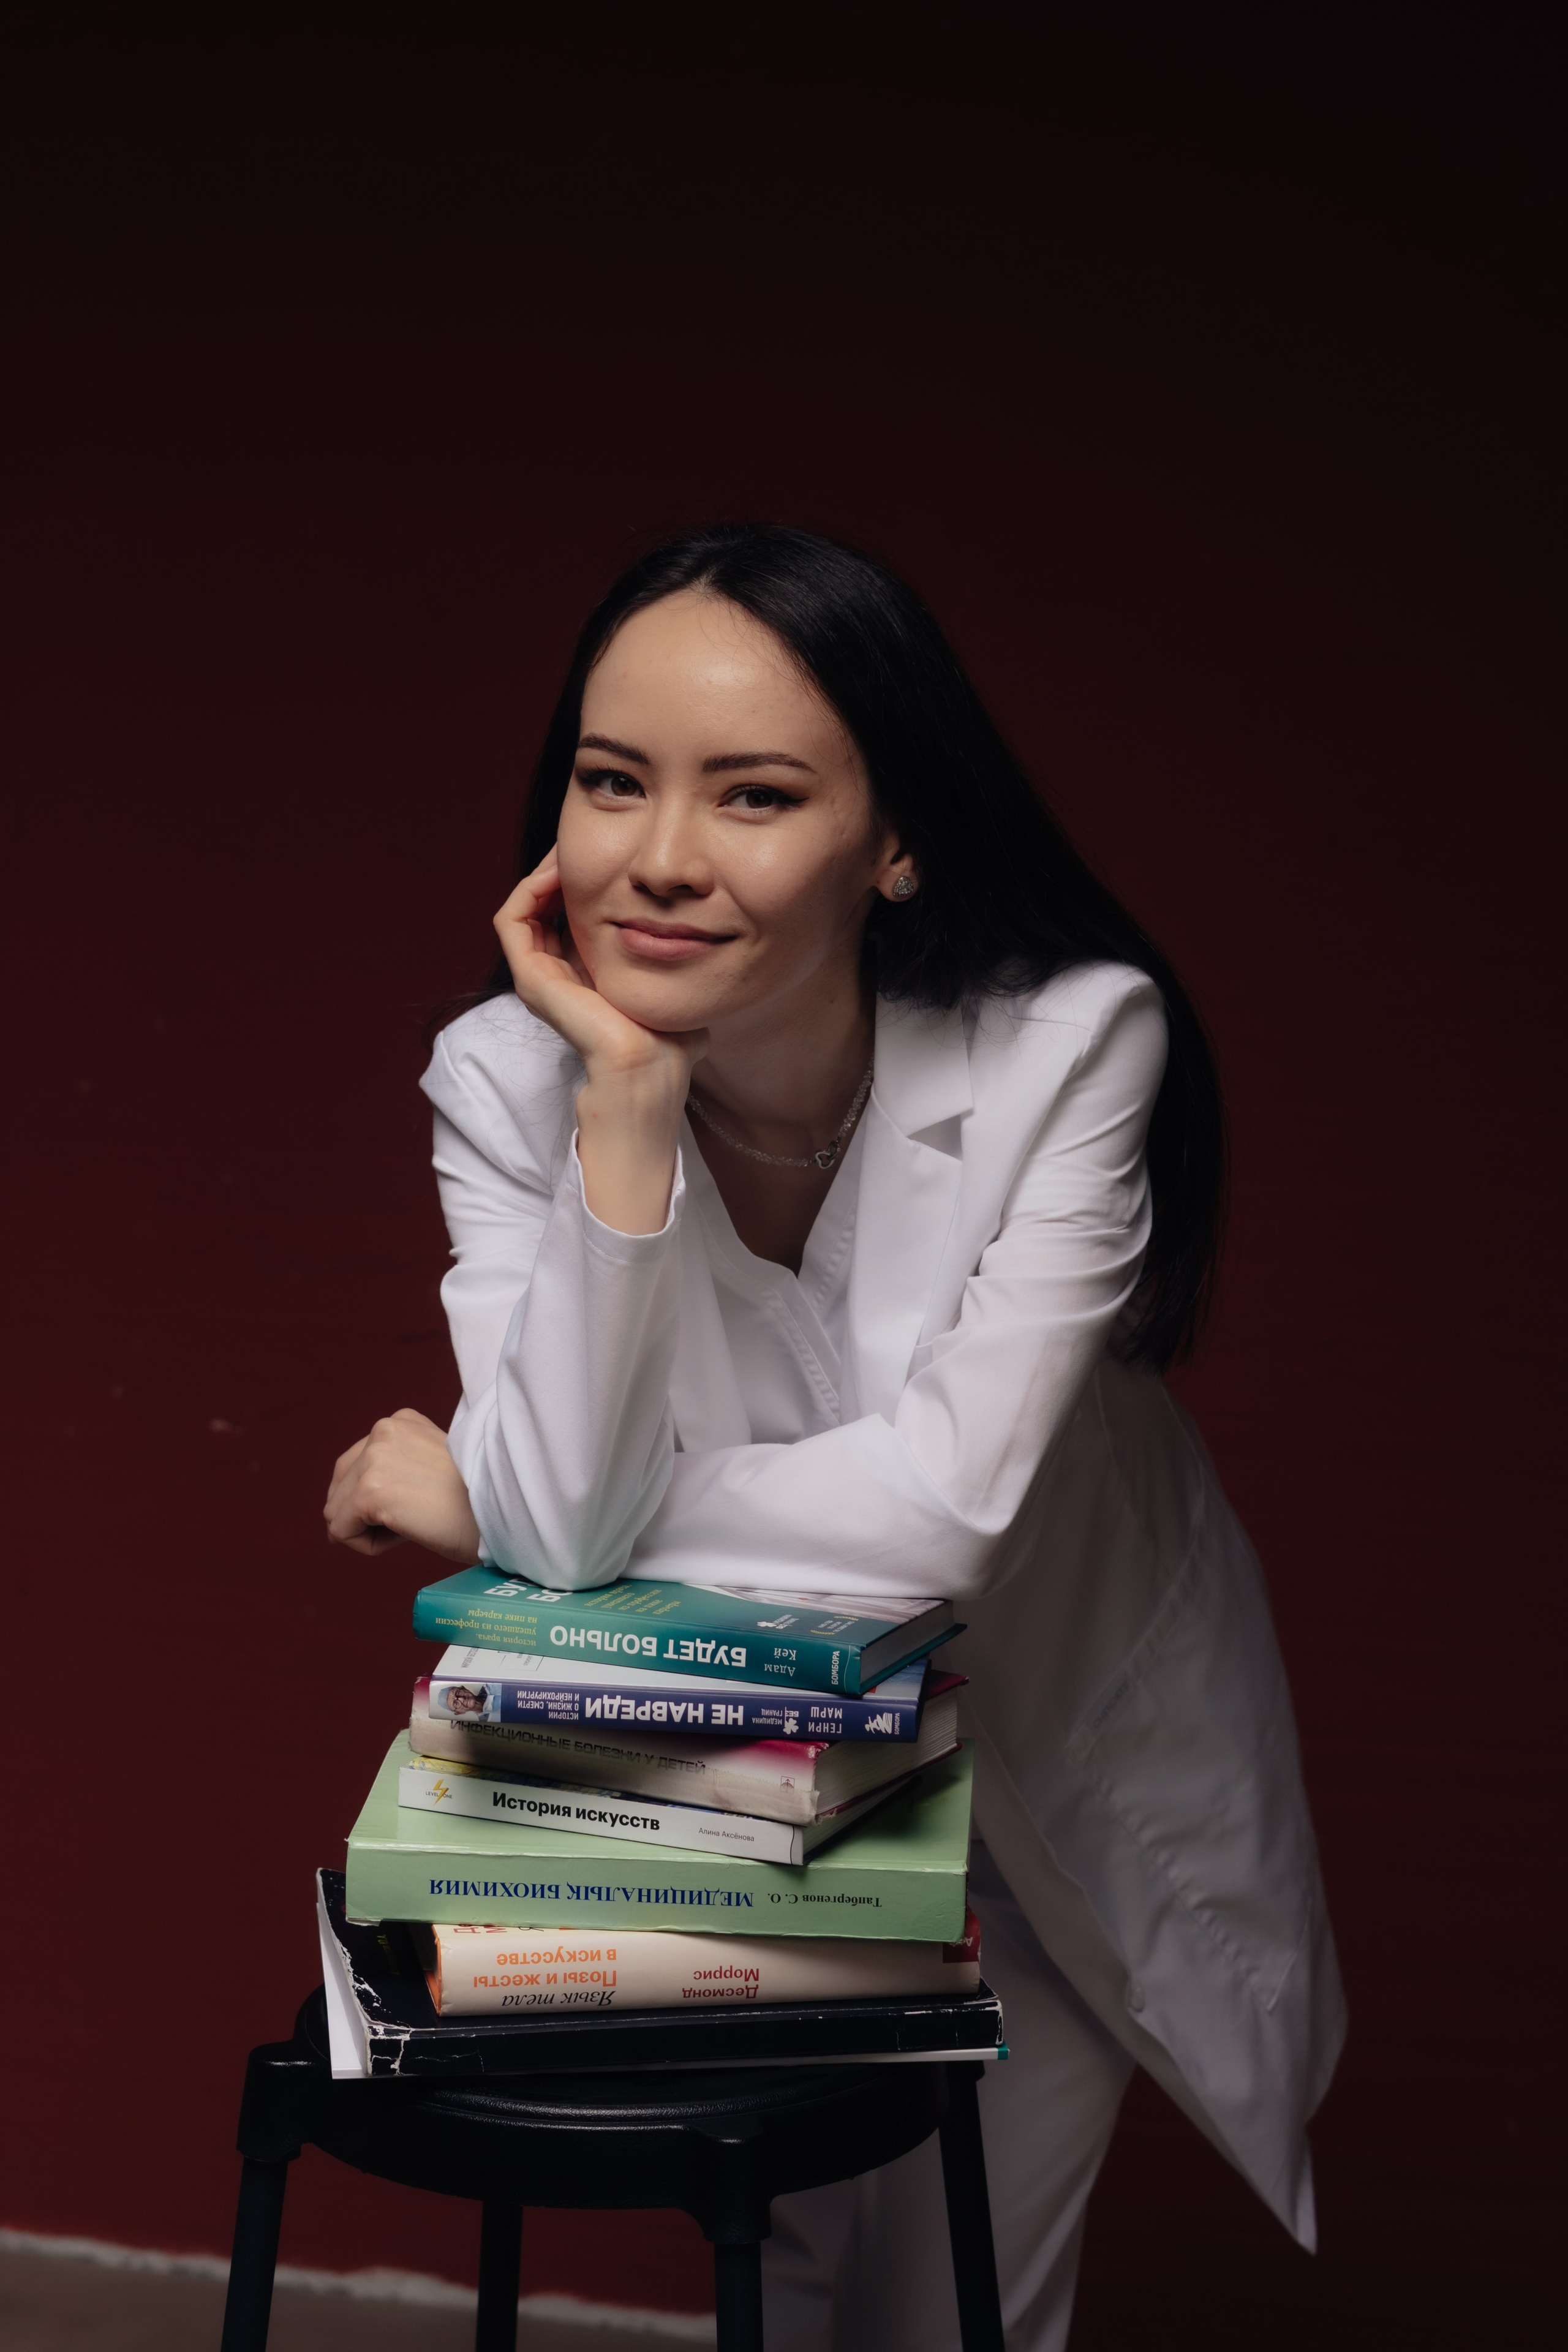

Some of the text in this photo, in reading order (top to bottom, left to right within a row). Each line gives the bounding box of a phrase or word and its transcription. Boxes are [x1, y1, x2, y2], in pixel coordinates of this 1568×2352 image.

[468, 1608, 503, 1621] карьеры
[505, 1614, 525, 1623] пике
[435, 1617, 480, 1629] профессии
[494, 1625, 537, 1635] ушедшего
[503, 1637, 537, 1646] история
[550, 1626, 747, 1667] БУДЕТ БОЛЬНО
[774, 1647, 797, 1660] Кей
[764, 1663, 796, 1677] Адам
[831, 1651, 840, 1685] БОМБОРА
[517, 1691, 573, 1702] НЕЙРОХИРУРГИИ
[518, 1700, 544, 1709] СМЕРТИ
[546, 1701, 572, 1710] ЖИЗНИ,
[586, 1694, 744, 1725] НЕ НАВРЕДИ
[549, 1711, 579, 1720] ИСТОРИИ
[810, 1706, 842, 1719] МАРШ
[809, 1722, 842, 1733] ГЕНРИ
[451, 1720, 706, 1774] ИНФЕКЦИОННЫЕ БОЛЕЗНИ У ДЕТЕЙ
[492, 1791, 660, 1831] История искусств
[698, 1828, 755, 1842] Алина Аксёнова
[429, 1879, 754, 1907] МЕДИЦИНАЛЫҚ БИОХИМИЯ
[767, 1893, 882, 1907] Тапбергенов С. О.
[497, 1946, 617, 1966] в искусстве
[473, 1970, 617, 1988] Позы и жесты
[693, 1965, 759, 1982] Моррис
[502, 1991, 617, 2007] Язык тела
[682, 1985, 758, 1999] Десмонд
